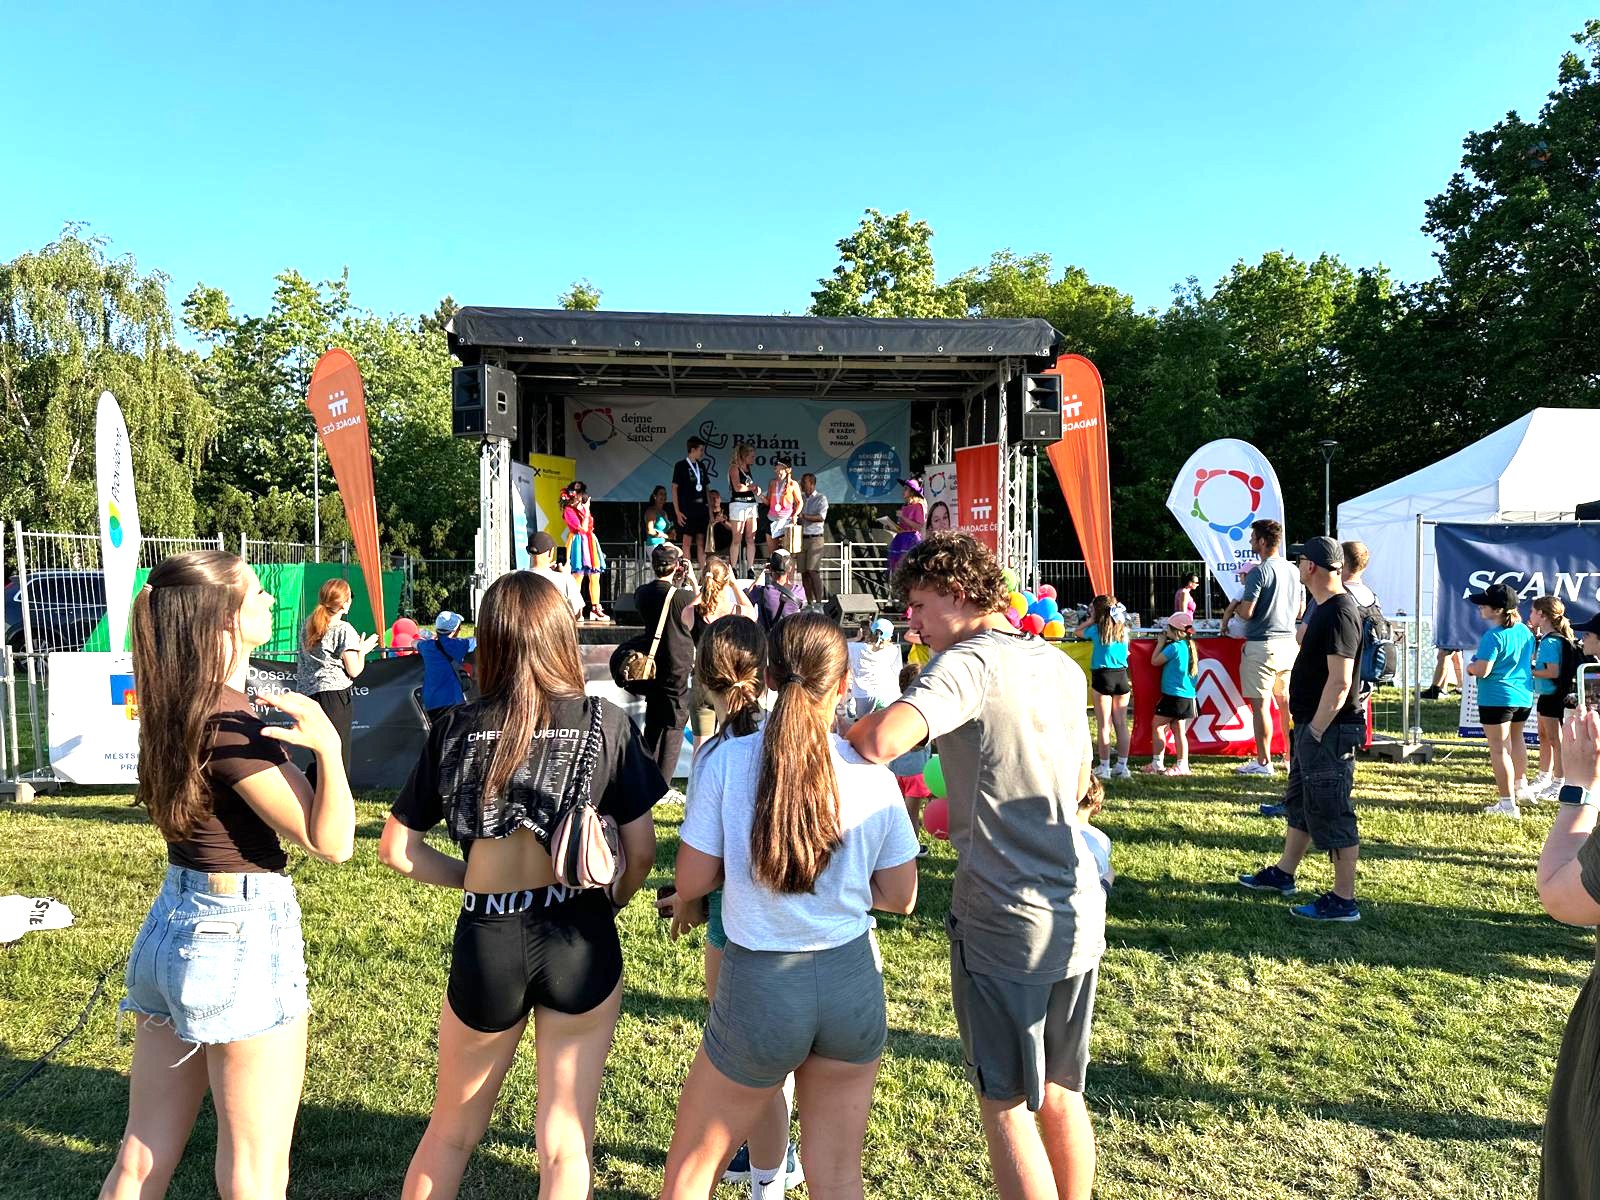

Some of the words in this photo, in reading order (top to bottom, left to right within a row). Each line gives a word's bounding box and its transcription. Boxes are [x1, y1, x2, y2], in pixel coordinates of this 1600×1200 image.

[621, 413, 653, 424] dejme
[635, 424, 667, 433] dětem
[627, 433, 654, 442] šanci
[732, 433, 799, 449] Běhám
[961, 525, 989, 533] NADACE
[1462, 570, 1600, 602] SCAN
